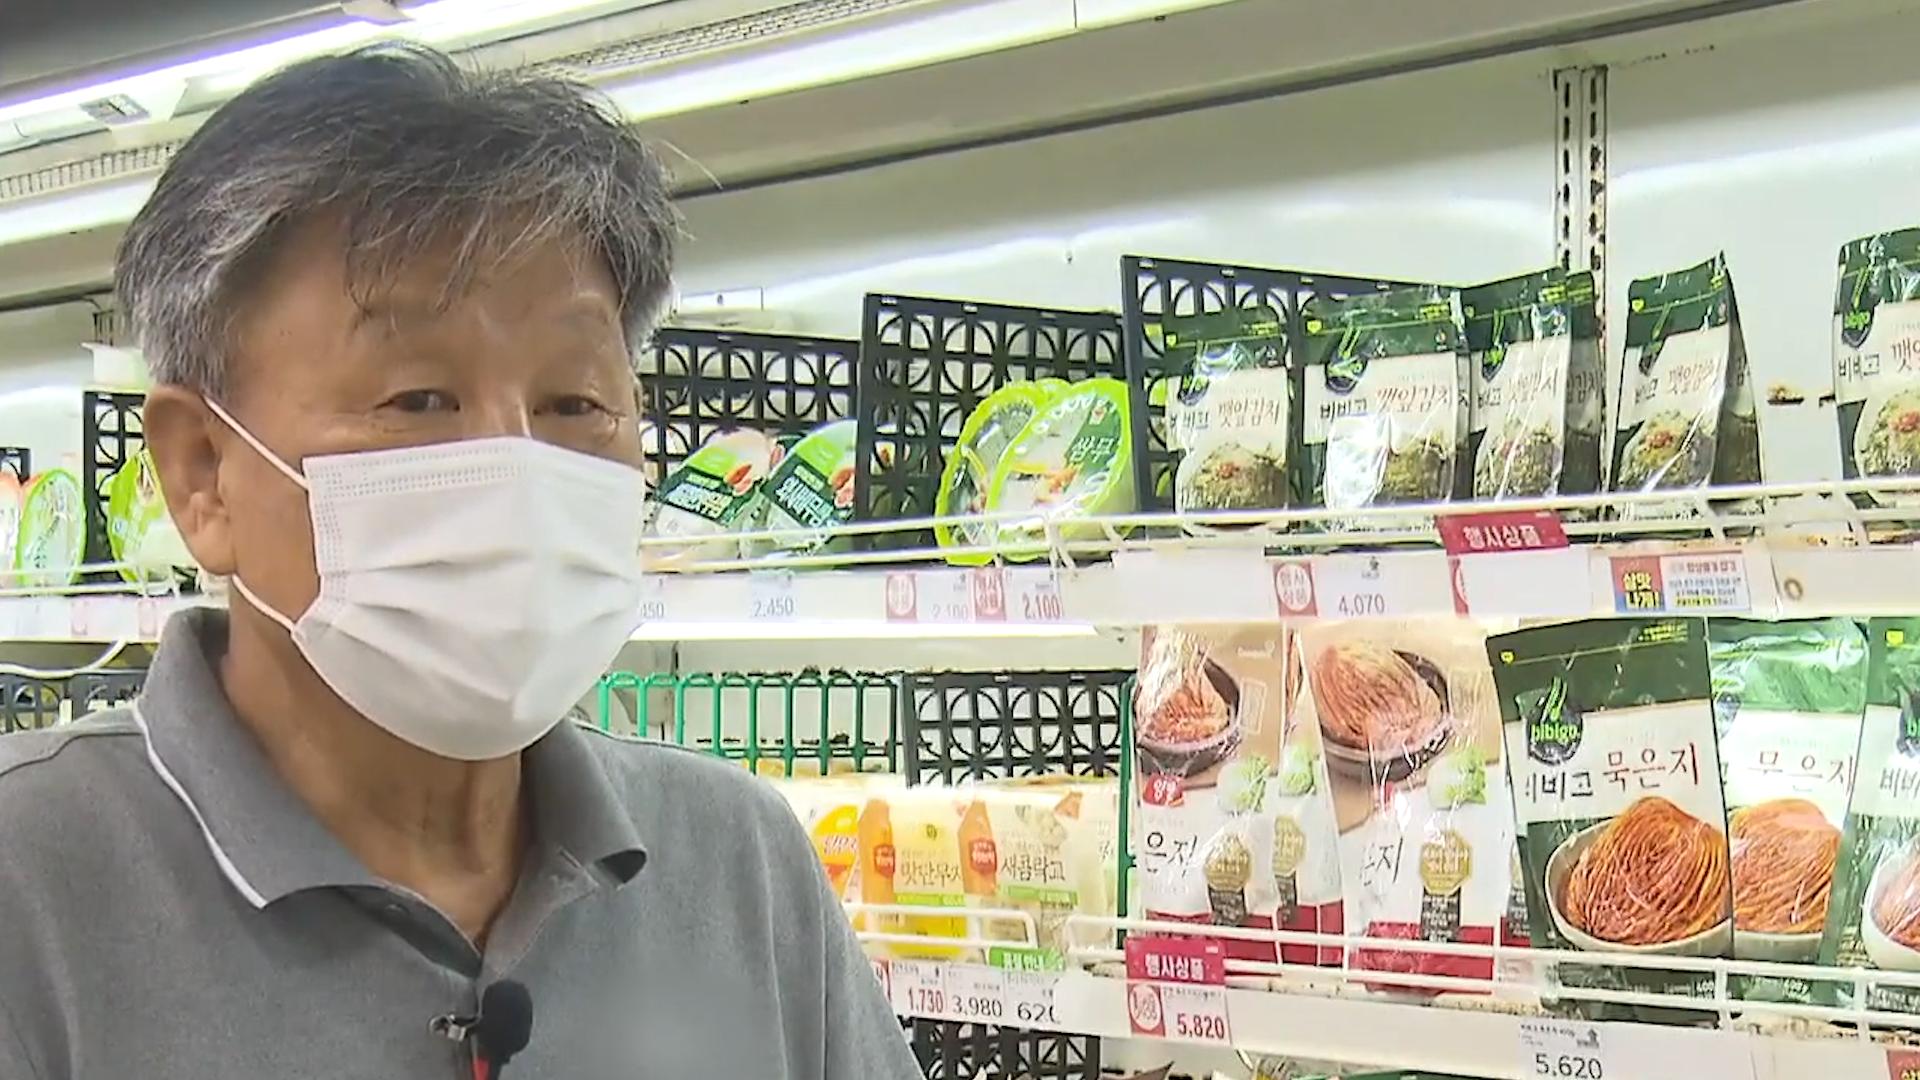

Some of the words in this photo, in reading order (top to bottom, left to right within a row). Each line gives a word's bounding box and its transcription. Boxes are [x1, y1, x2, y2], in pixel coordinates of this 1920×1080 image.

[1218, 397, 1281, 428] 깻잎김치
[1320, 397, 1368, 423] 비비고
[1462, 523, 1543, 549] 행사상품
[1338, 594, 1385, 617] 4,070
[1602, 742, 1700, 793] 묵은지
[1144, 952, 1205, 981] 행사상품
[907, 988, 944, 1014] 1,730
[952, 995, 1003, 1018] 3,980
[1176, 1012, 1225, 1040] 5,820
[1534, 1052, 1603, 1080] 5,620
